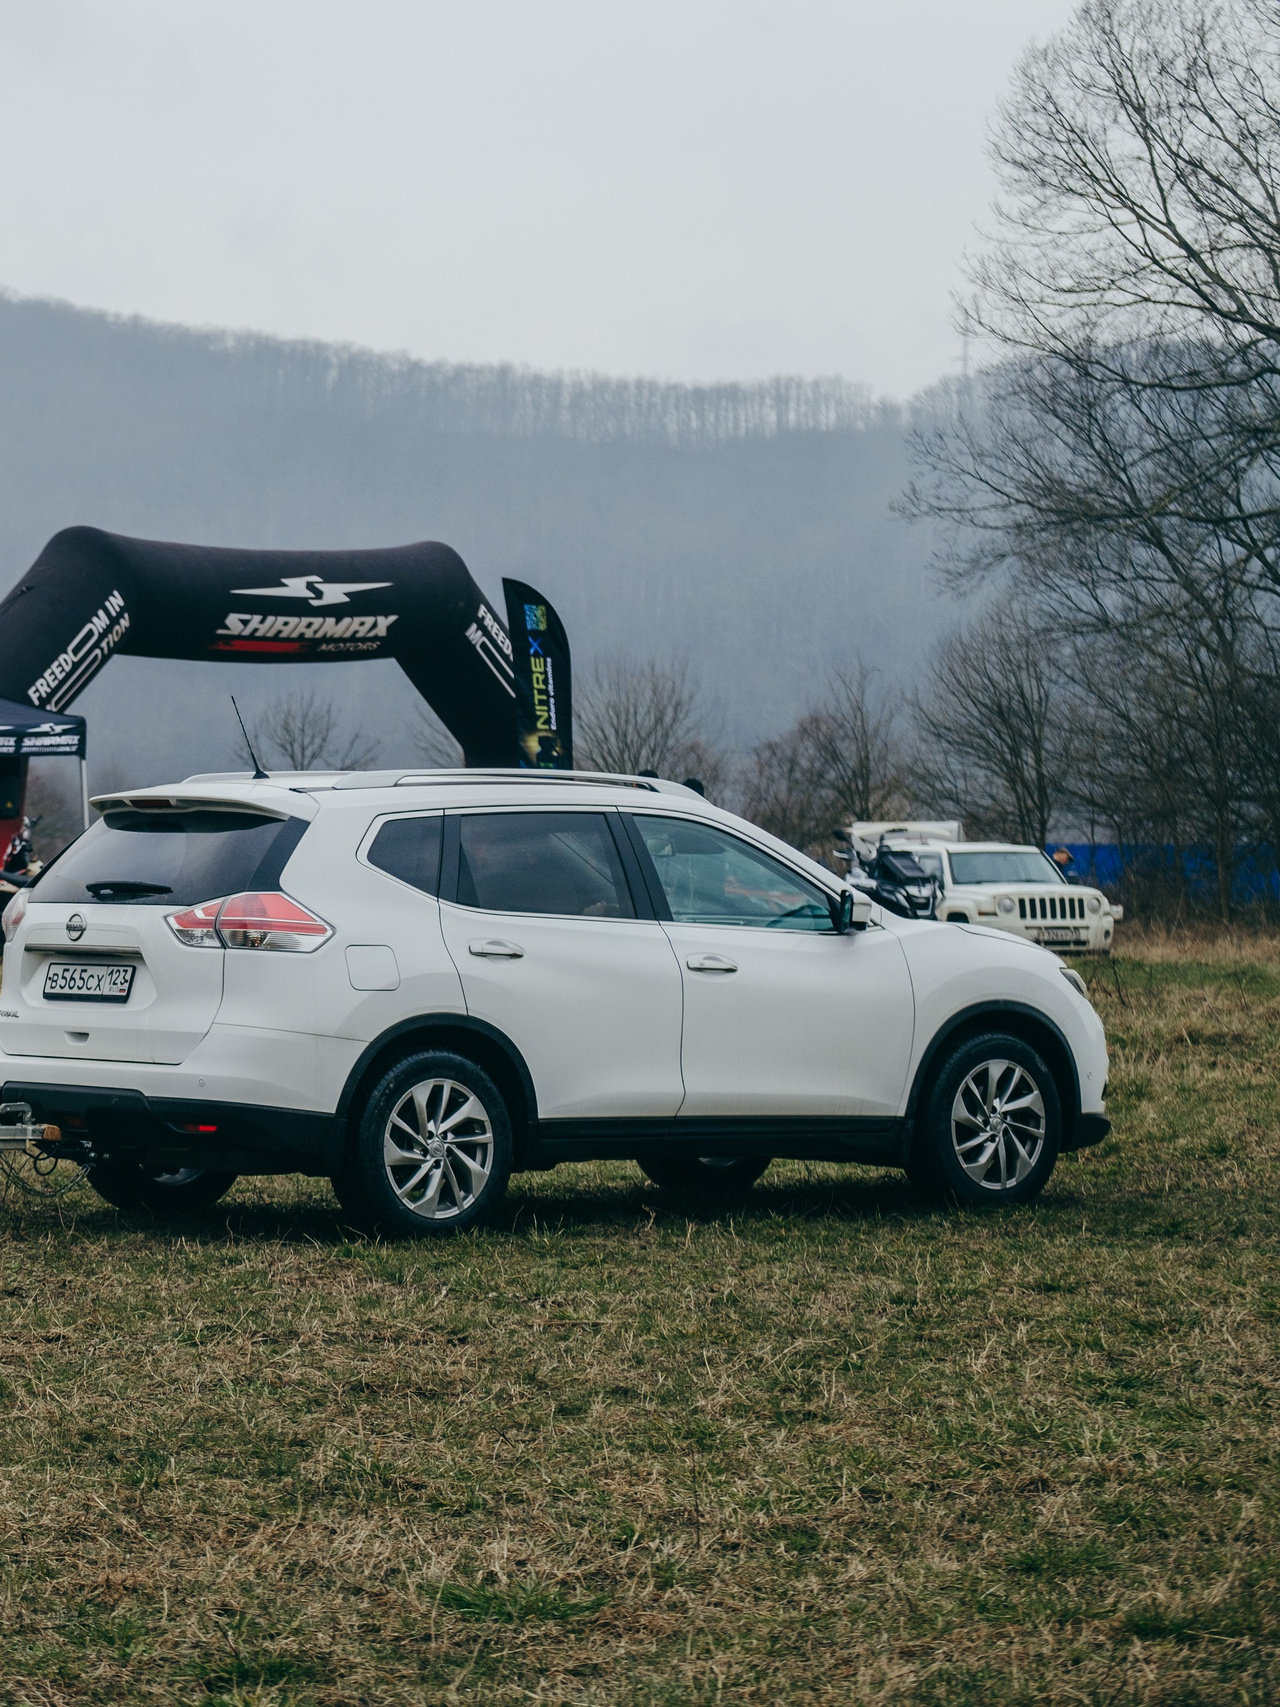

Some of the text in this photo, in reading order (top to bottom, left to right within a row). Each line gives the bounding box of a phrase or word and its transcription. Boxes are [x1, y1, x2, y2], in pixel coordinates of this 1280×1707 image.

[27, 589, 125, 706] FREEDOM IN
[216, 612, 400, 639] SHARMAX
[317, 641, 381, 653] MOTORS
[477, 603, 514, 662] FREED
[45, 612, 130, 712] OTION
[528, 635, 550, 731] NITREX
[49, 968, 129, 992] B565CX 123
